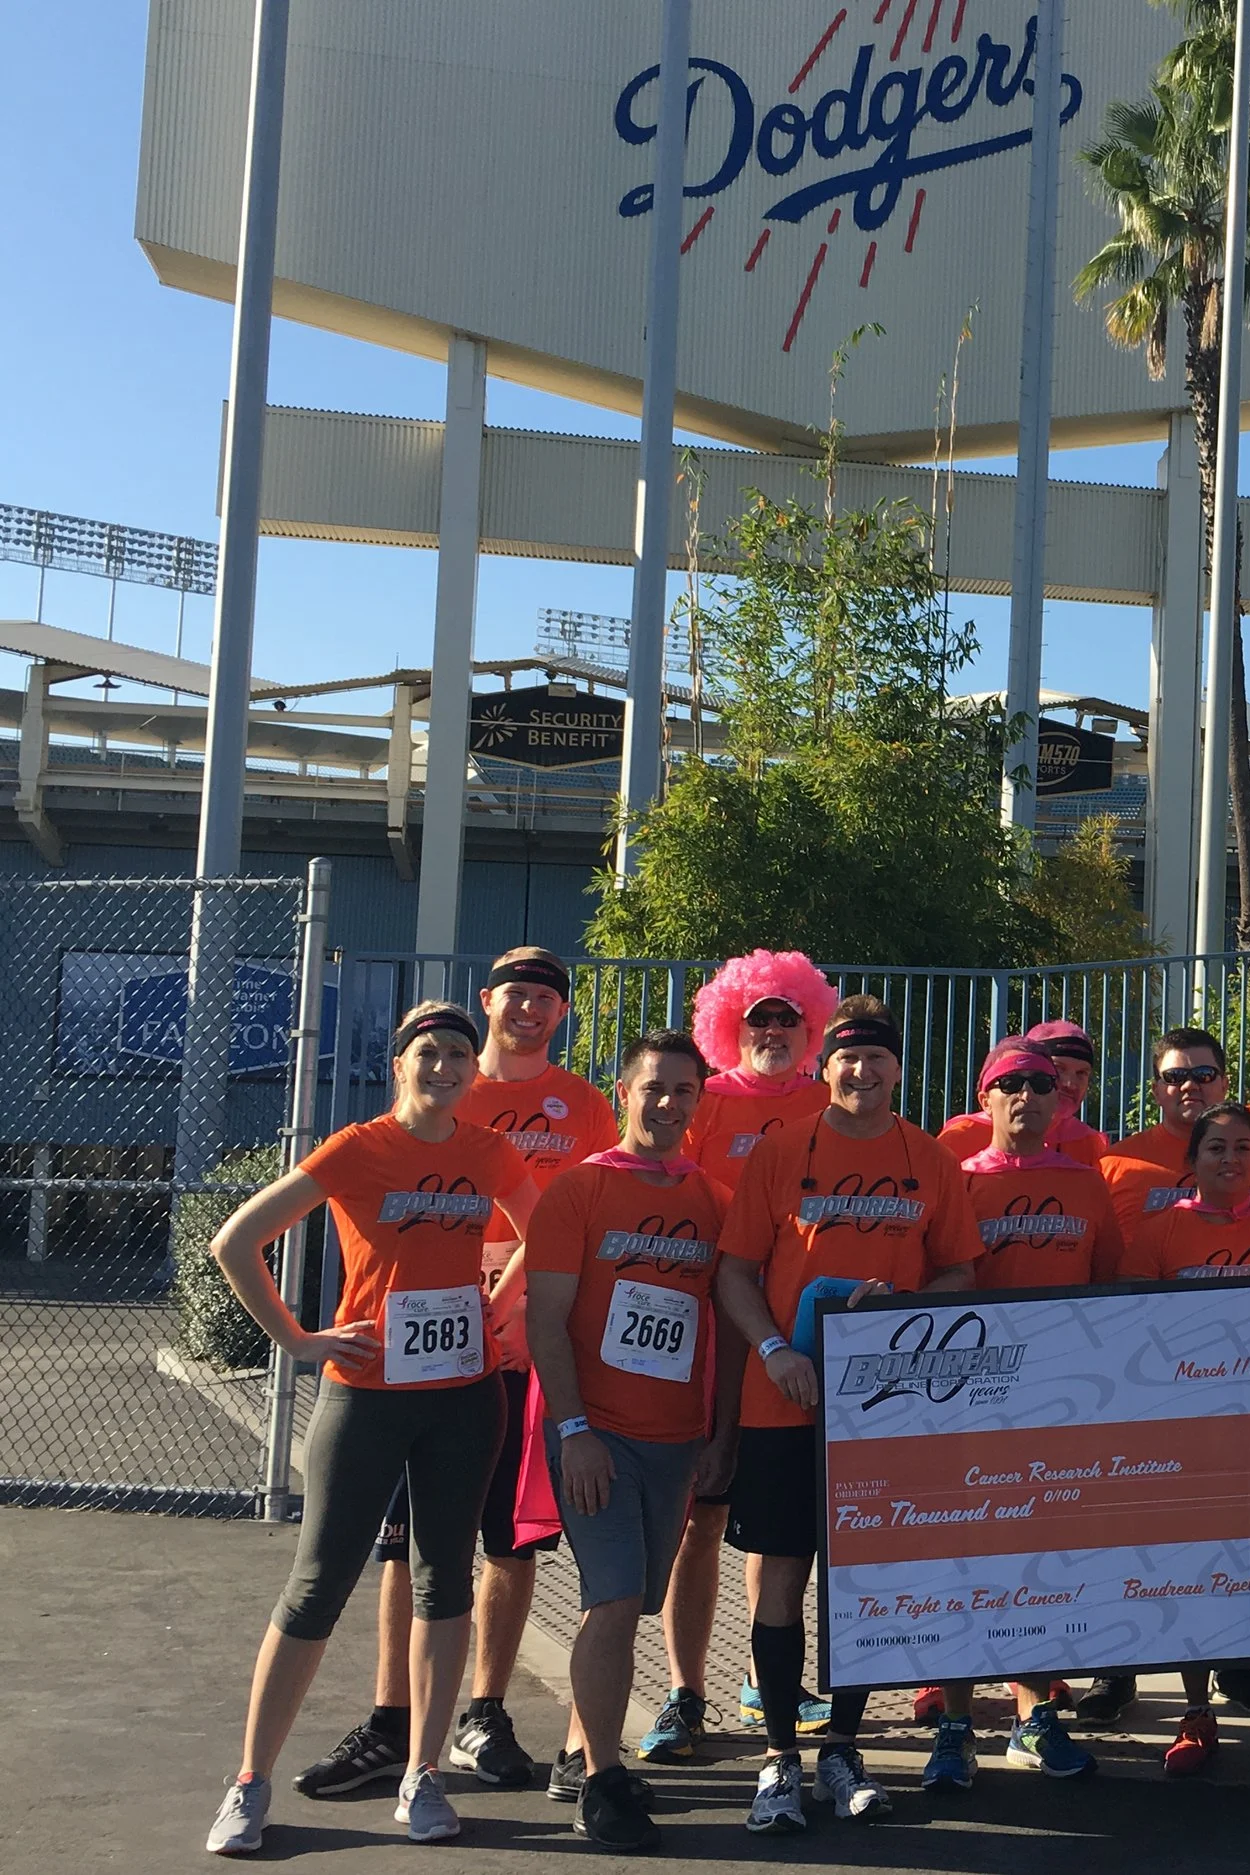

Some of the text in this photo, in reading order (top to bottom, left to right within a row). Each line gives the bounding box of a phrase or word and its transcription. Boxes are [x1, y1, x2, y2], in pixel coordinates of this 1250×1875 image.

[529, 709, 622, 728] SECURITY
[528, 729, 609, 748] BENEFIT
[1038, 743, 1080, 766] M570
[404, 1315, 469, 1355] 2683
[620, 1310, 685, 1353] 2669
[836, 1344, 1028, 1396] BOUDREAU
[1174, 1359, 1228, 1381] March
[931, 1375, 1020, 1388] CORPORATION
[969, 1384, 1010, 1406] years
[964, 1454, 1183, 1486] Cancer Research Institute
[834, 1488, 881, 1499] ORDER OF
[835, 1482, 854, 1490] PAY
[856, 1481, 869, 1489] TO
[835, 1504, 883, 1530] Five
[890, 1499, 988, 1527] Thousand
[994, 1496, 1036, 1519] and
[1123, 1577, 1205, 1599] Boudreau
[834, 1583, 1086, 1620] FOR The Fight to End Cancer!
